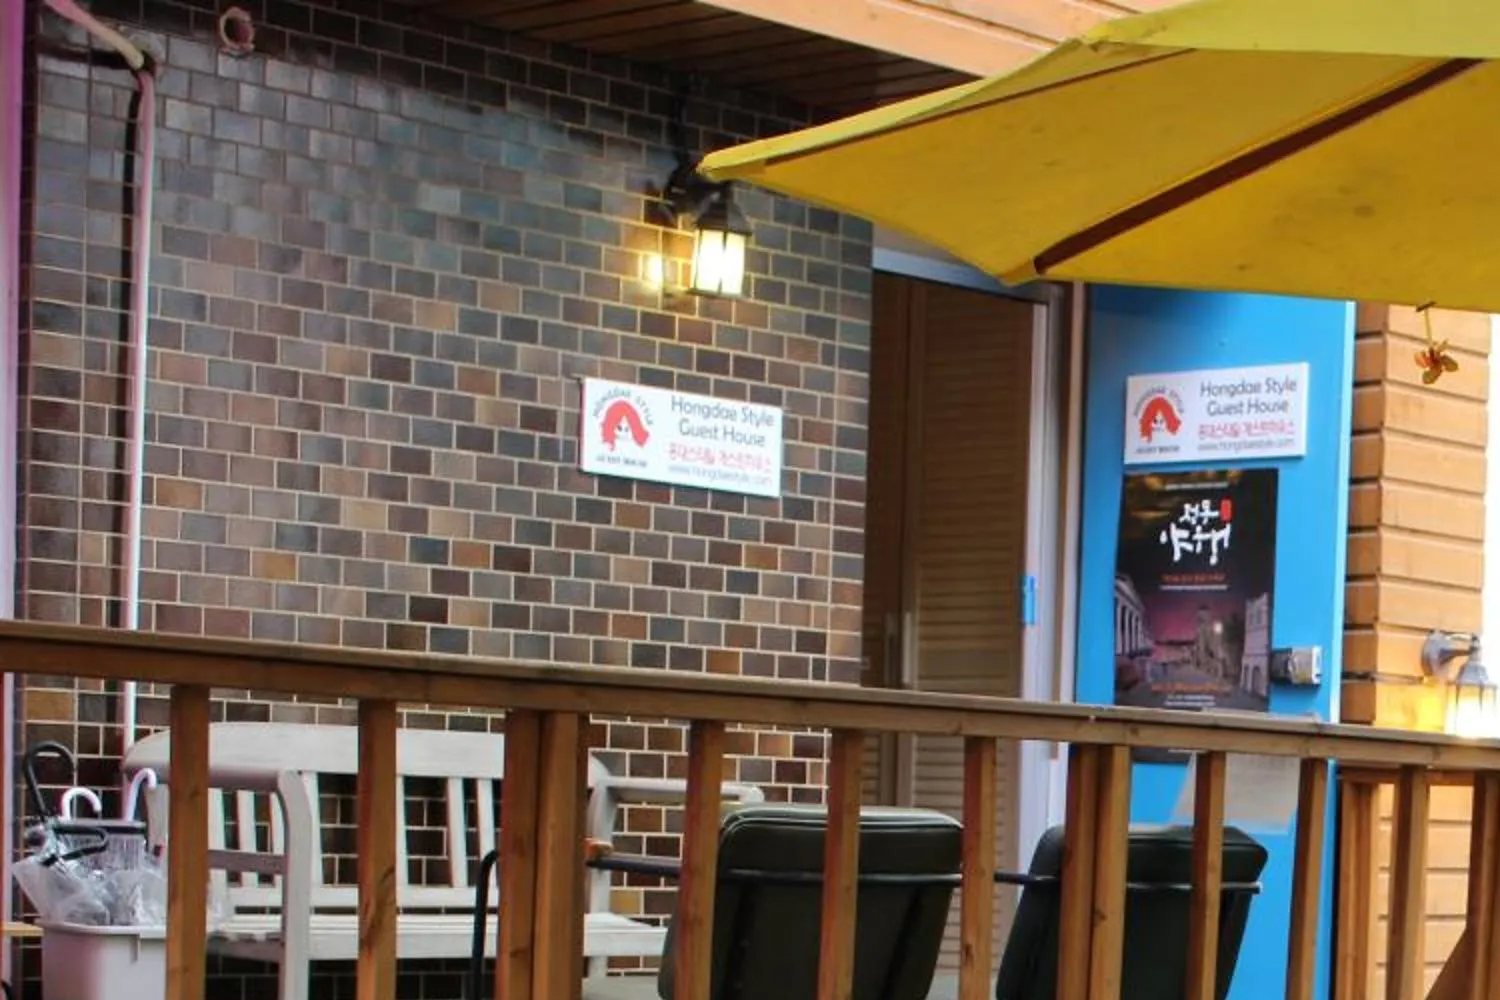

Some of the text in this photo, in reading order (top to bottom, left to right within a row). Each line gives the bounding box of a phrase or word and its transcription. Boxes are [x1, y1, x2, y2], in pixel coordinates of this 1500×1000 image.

[1201, 375, 1297, 398] Hongdae Style
[670, 394, 775, 429] Hongdae Style
[1207, 397, 1289, 417] Guest House
[679, 418, 766, 447] Guest House
